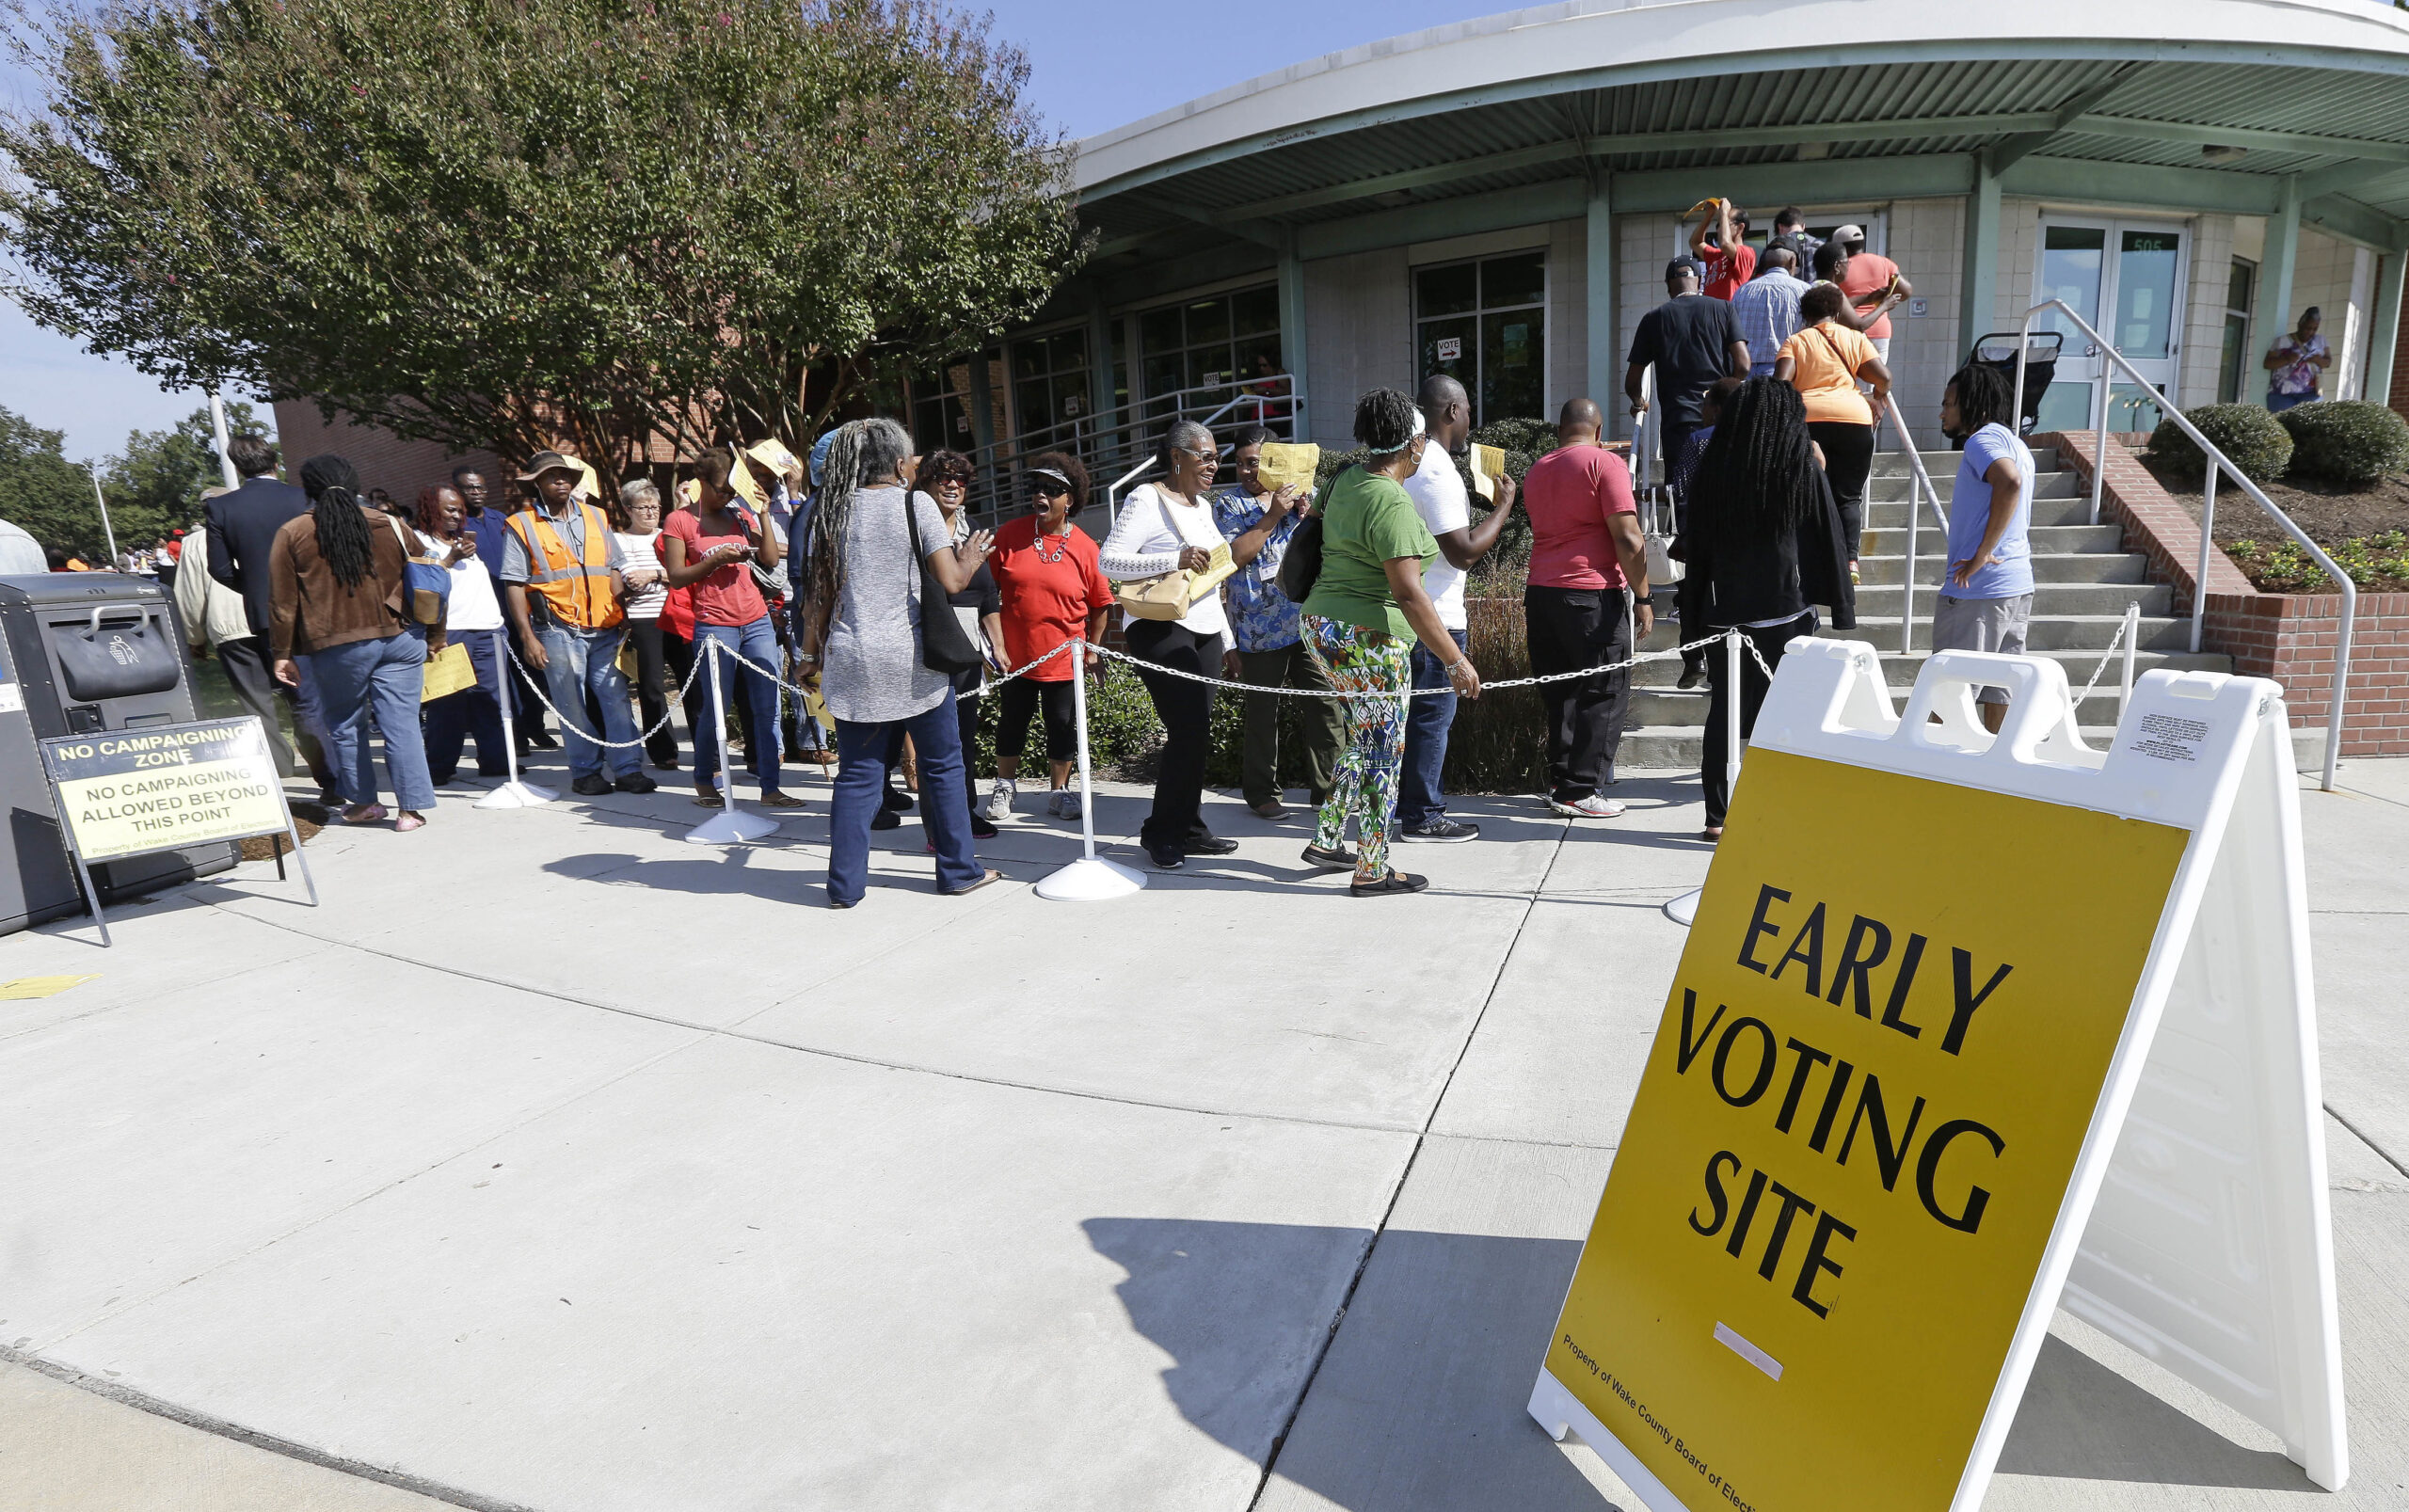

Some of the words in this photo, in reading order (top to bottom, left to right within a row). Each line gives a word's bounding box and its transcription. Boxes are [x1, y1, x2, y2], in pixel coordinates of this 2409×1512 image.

[2133, 238, 2162, 256] 505
[1438, 340, 1460, 349] VOTE
[1204, 374, 1219, 383] VOTE
[58, 745, 93, 761] NO
[99, 725, 247, 756] CAMPAIGNING
[134, 748, 193, 768] ZONE
[87, 787, 116, 802] NO
[121, 768, 251, 796] CAMPAIGNING
[82, 797, 183, 823] ALLOWED
[190, 785, 268, 804] BEYOND
[131, 816, 173, 832] THIS
[180, 806, 231, 825] POINT
[91, 844, 130, 854] Property
[143, 836, 168, 846] Wake
[1736, 883, 2014, 1057] EARLY
[1676, 986, 2006, 1235] VOTING
[1687, 1150, 1858, 1321] SITE
[1563, 1333, 1600, 1376] Property
[1601, 1371, 1612, 1385] of
[1611, 1377, 1636, 1409] Wake
[1637, 1404, 1674, 1445] County
[1674, 1438, 1708, 1476] Board
[1708, 1472, 1723, 1488] of
